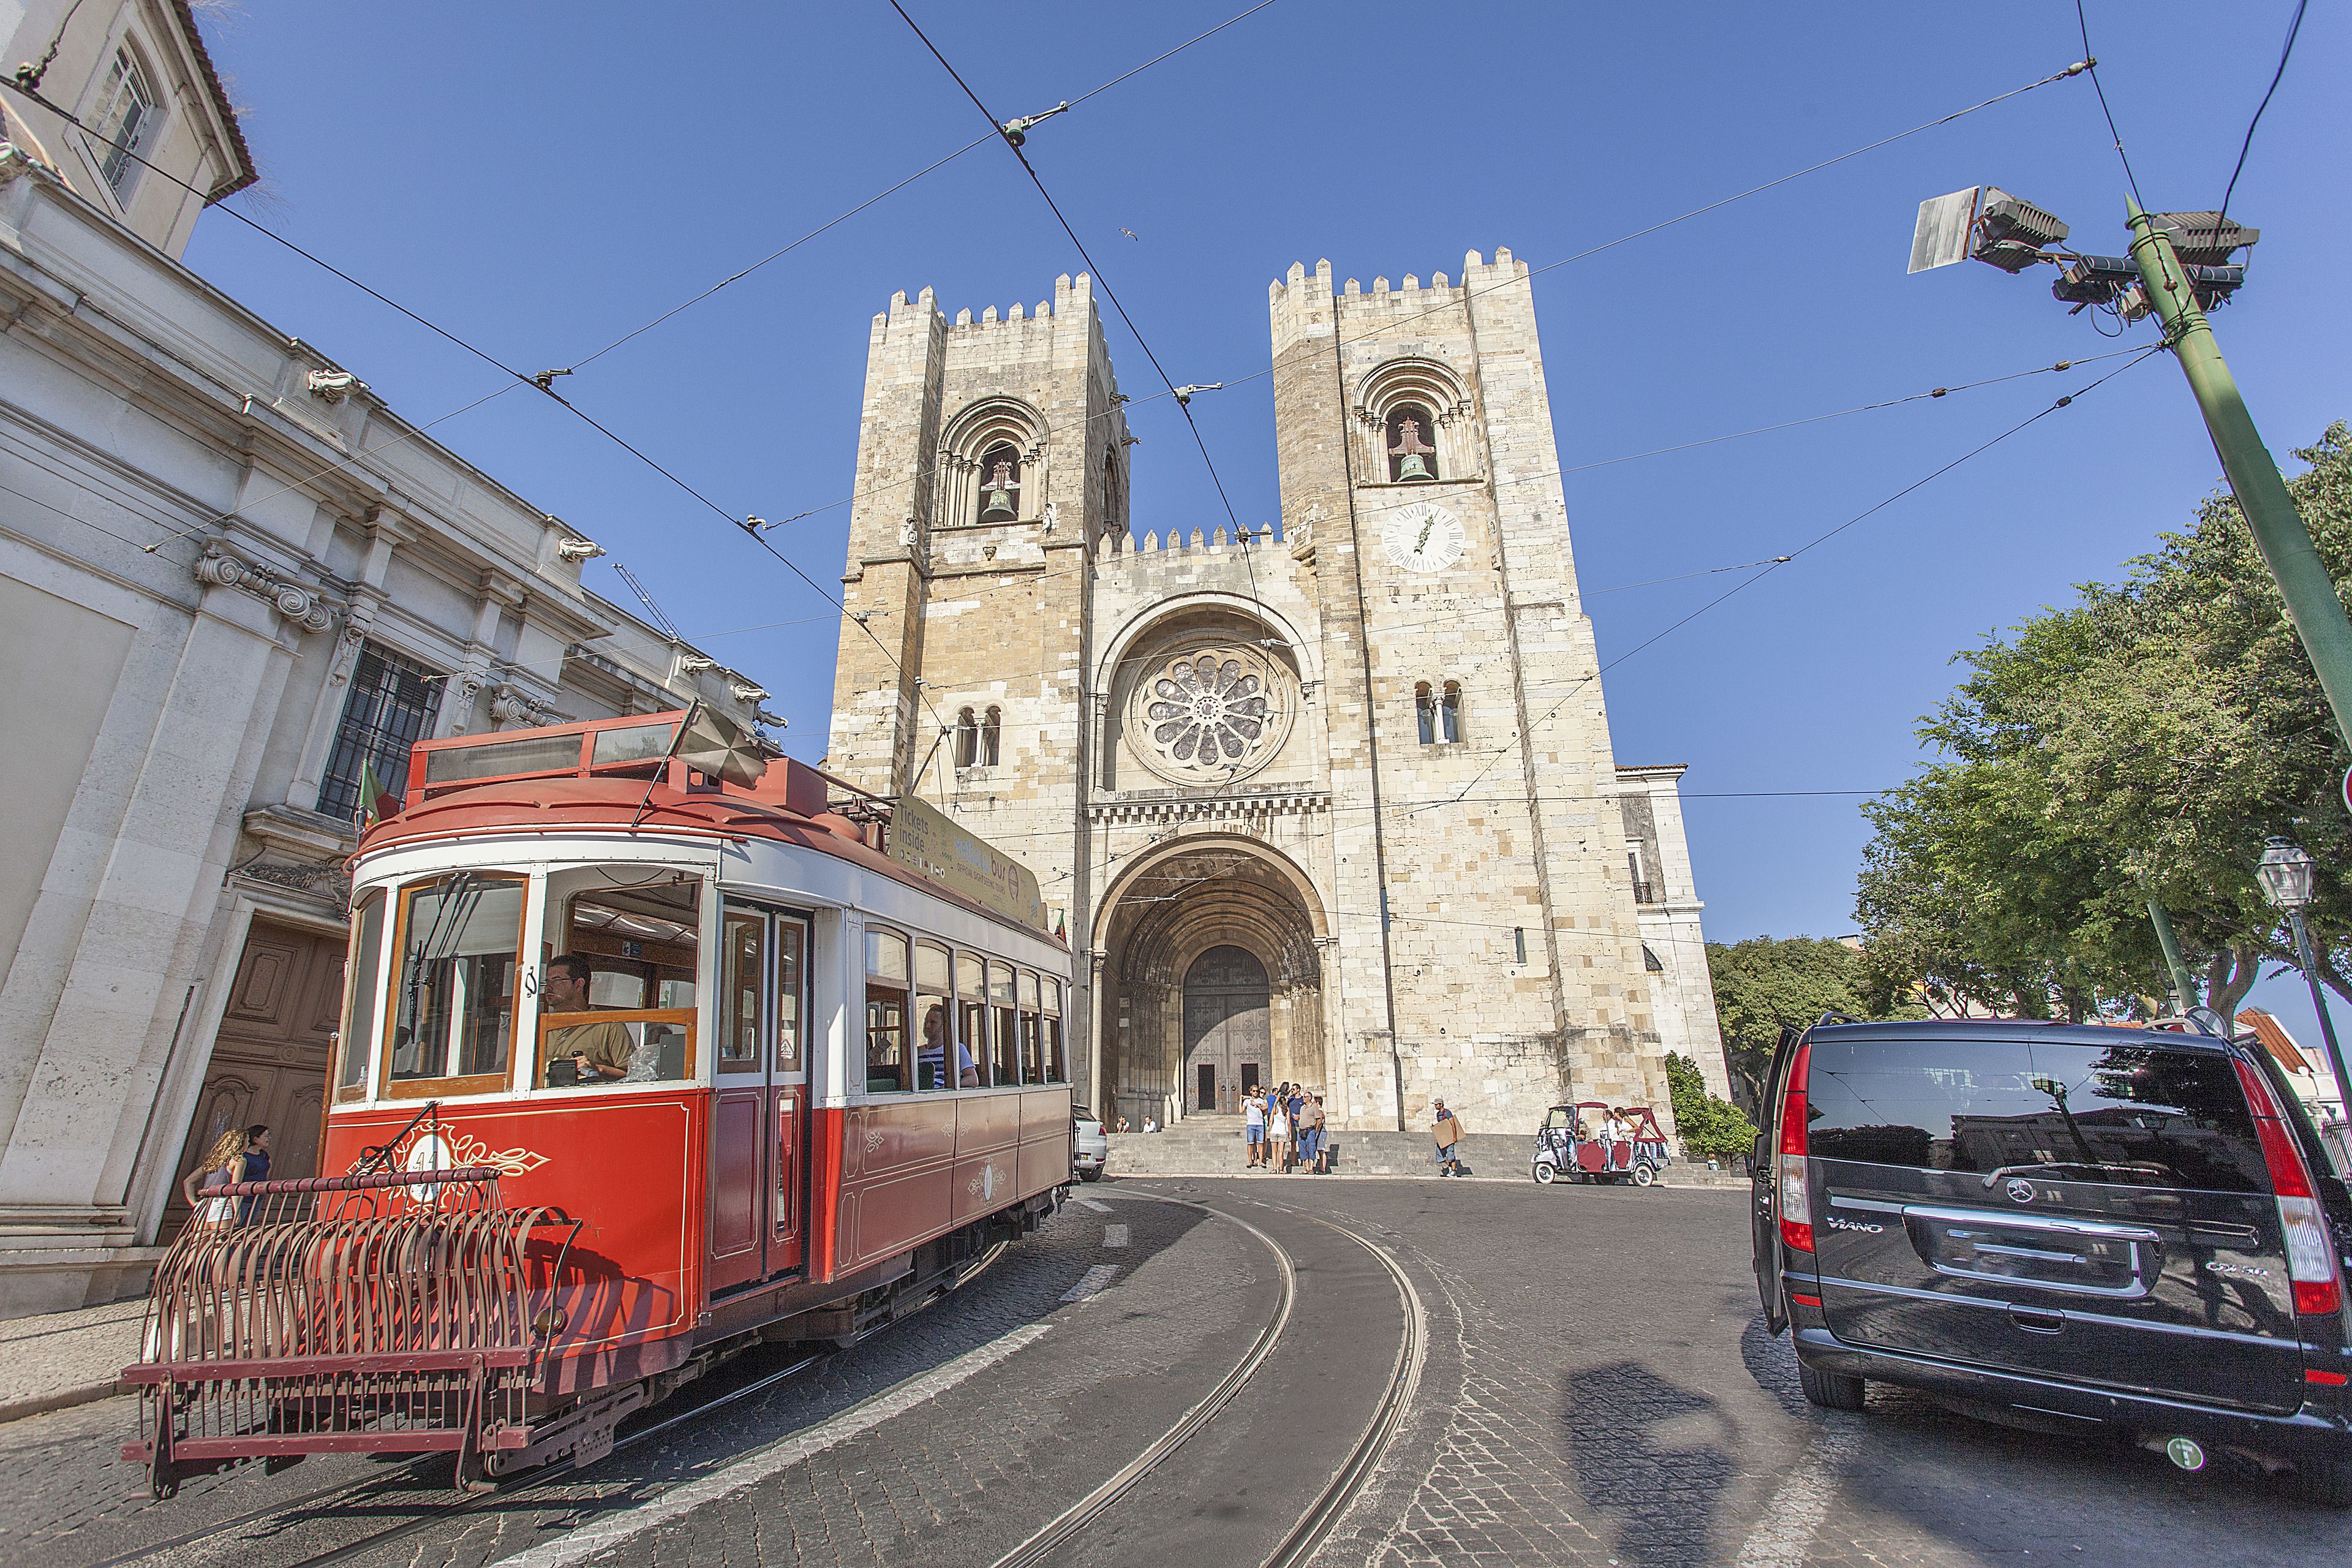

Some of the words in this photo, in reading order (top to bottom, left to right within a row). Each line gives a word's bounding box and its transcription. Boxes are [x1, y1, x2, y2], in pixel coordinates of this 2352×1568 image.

[899, 802, 929, 835] Tickets
[899, 823, 925, 853] inside
[957, 862, 973, 878] OFFICIAL
[991, 851, 1006, 881] bus
[1826, 1217, 1884, 1234] VIANO
